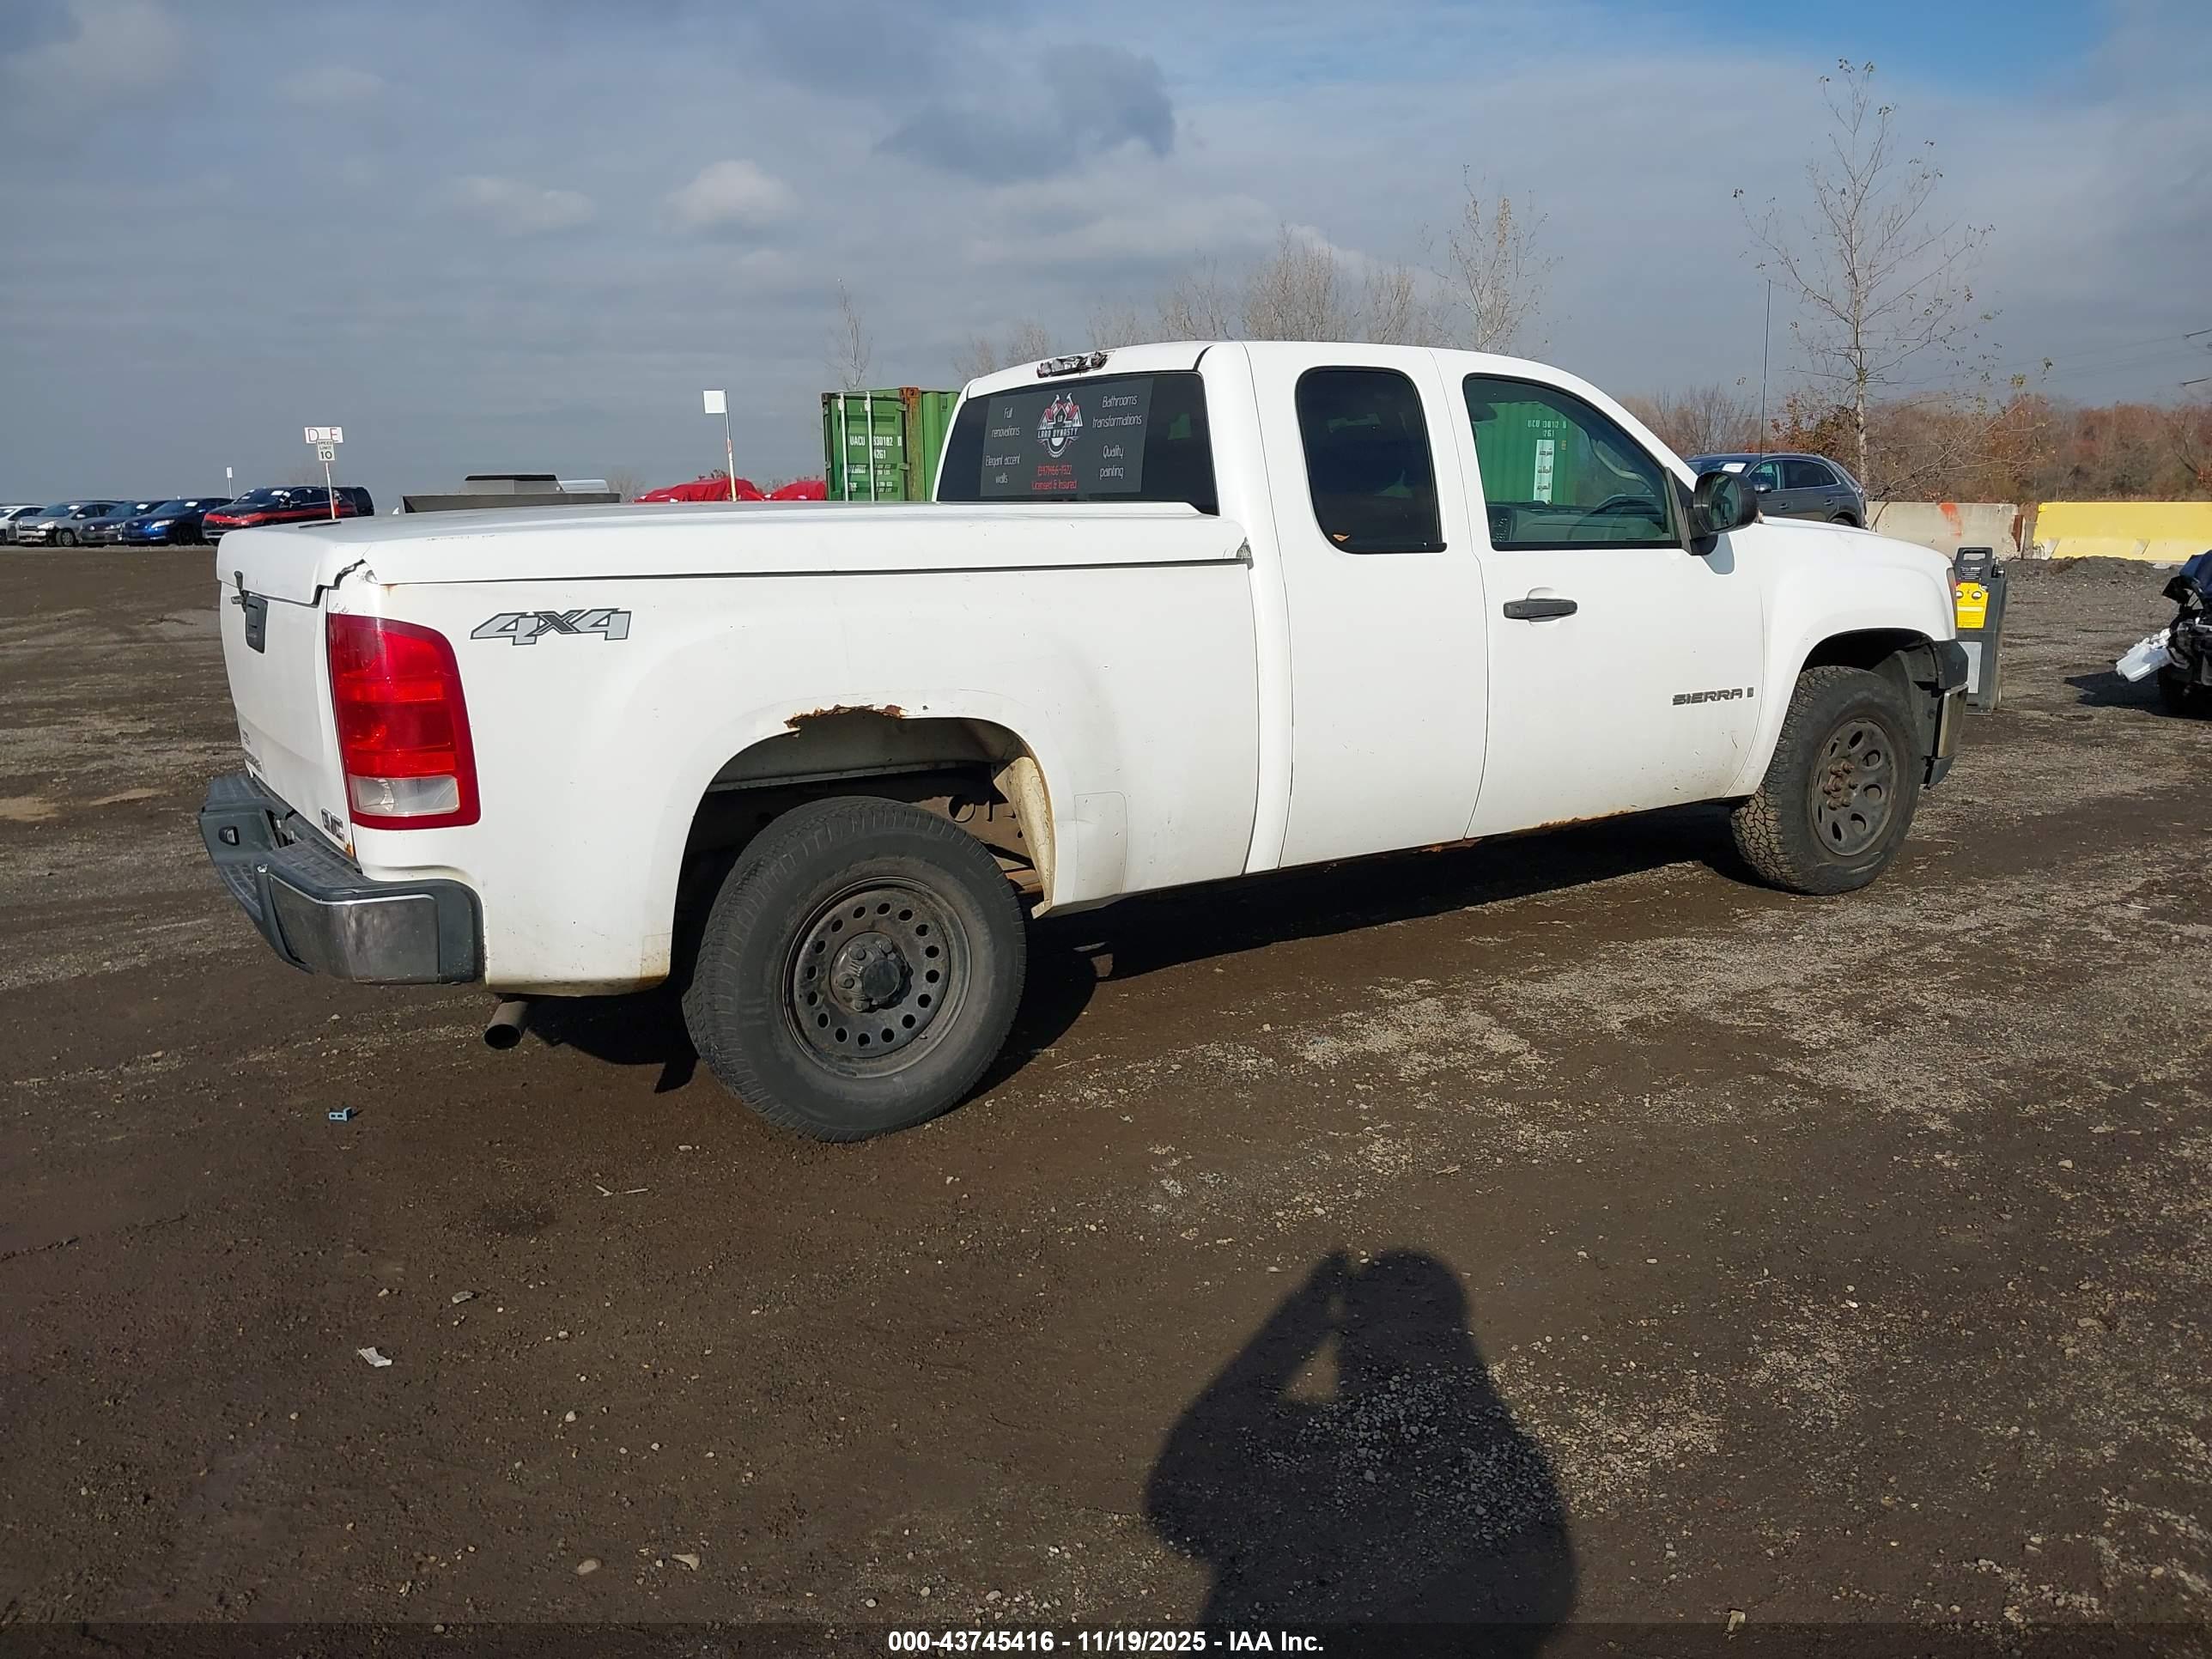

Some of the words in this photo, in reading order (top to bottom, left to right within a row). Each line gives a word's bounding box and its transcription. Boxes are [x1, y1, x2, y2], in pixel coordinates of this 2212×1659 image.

[1102, 395, 1138, 408] Bathrooms
[1004, 407, 1013, 419] Full
[1092, 413, 1142, 428] transformations
[307, 428, 319, 442] D
[992, 426, 1020, 438] renovations
[849, 435, 866, 446] UACU
[320, 451, 332, 459] 10
[1103, 445, 1124, 459] Quality
[985, 454, 1004, 468] Elegant
[1004, 453, 1021, 465] accent
[995, 473, 1008, 484] walls
[1099, 465, 1124, 480] painting
[1672, 688, 1743, 706] SIERRA
